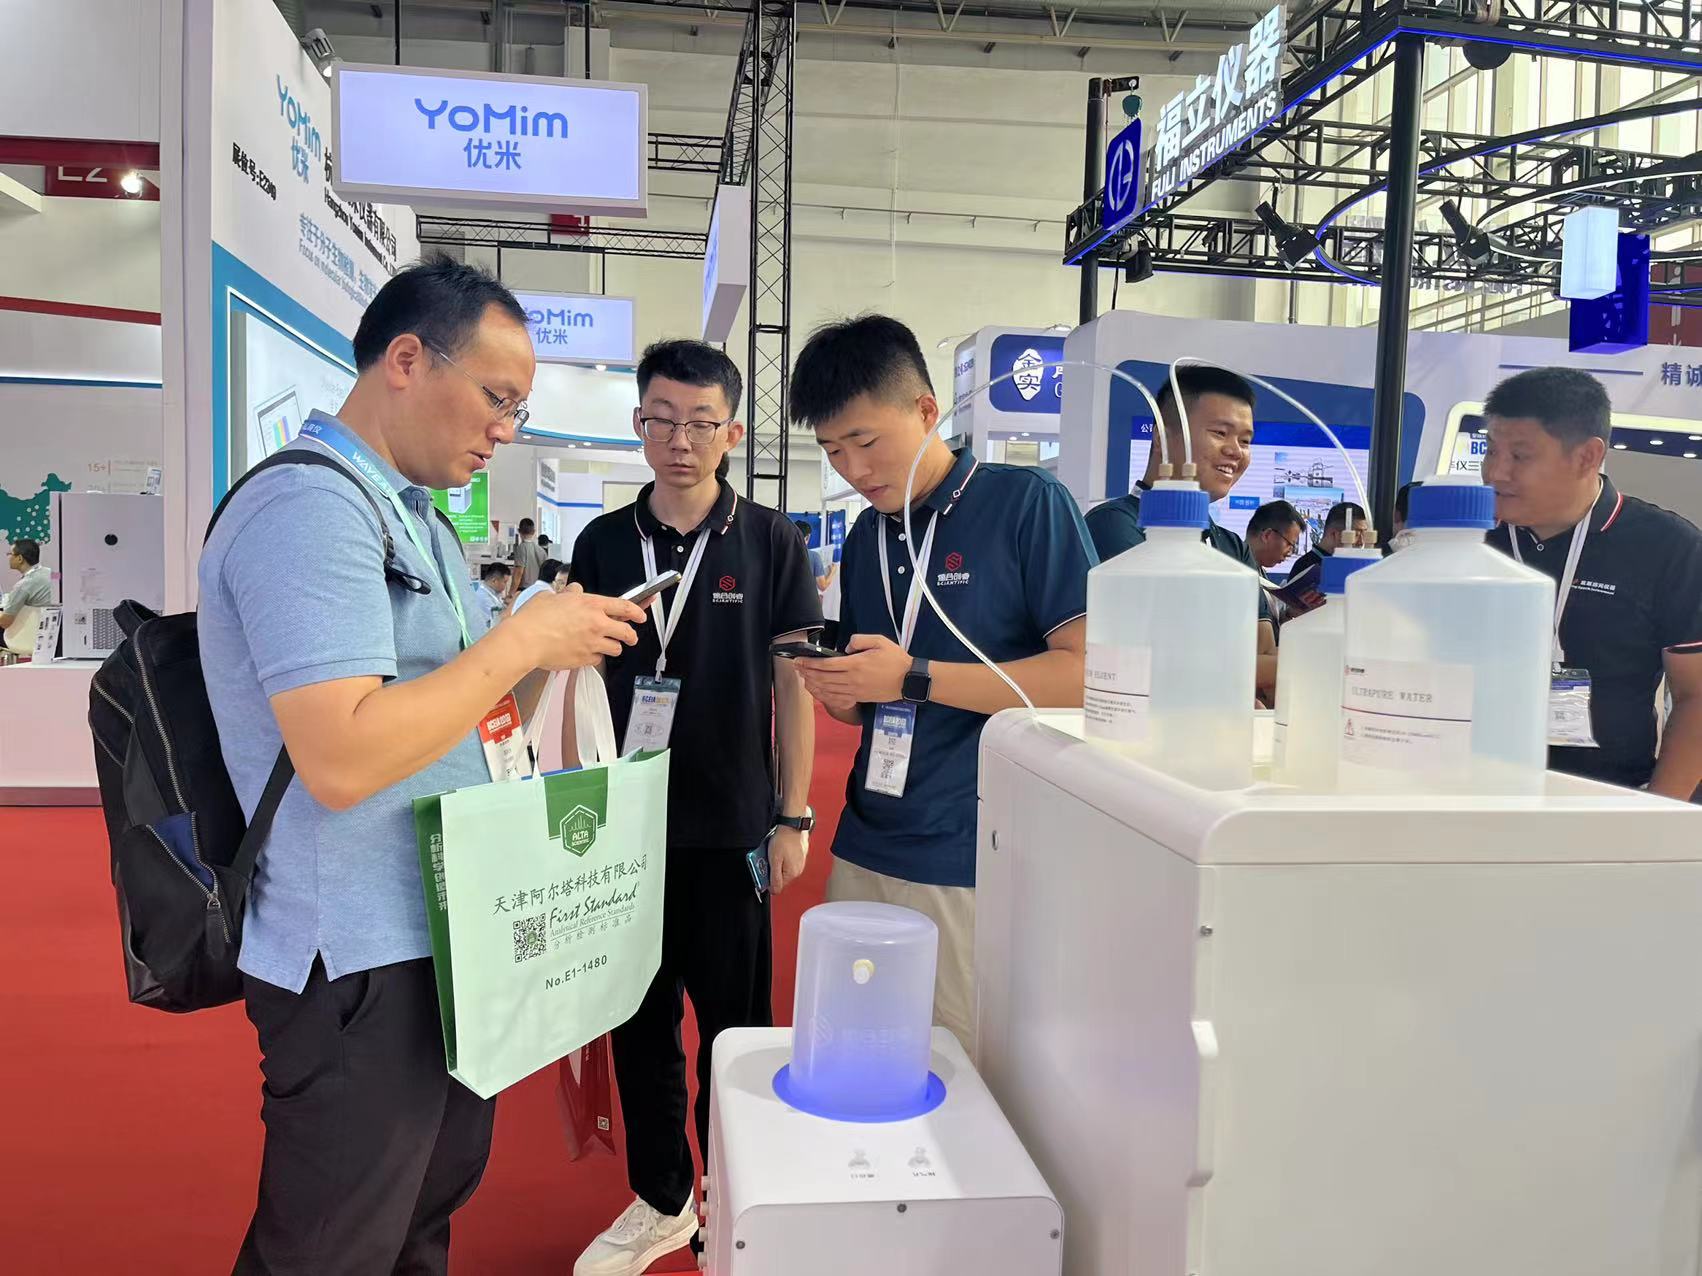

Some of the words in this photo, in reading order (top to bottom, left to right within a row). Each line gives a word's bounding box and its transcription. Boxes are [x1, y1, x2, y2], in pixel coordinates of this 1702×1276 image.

[1155, 4, 1281, 171] 福立仪器
[276, 74, 321, 162] YoMim
[414, 98, 568, 138] YoMim
[463, 137, 522, 170] 优米
[1151, 169, 1176, 201] FULI
[1179, 91, 1277, 181] INSTRUMENTS
[527, 309, 594, 328] oMim
[536, 327, 568, 345] 优米
[1399, 691, 1433, 703] WATER
[572, 830, 589, 841] ALTA
[493, 854, 647, 915] 天津阿尔塔科技有限公司
[550, 903, 581, 928] First
[584, 883, 637, 916] Standard
[546, 955, 608, 989] No.E1-1480
